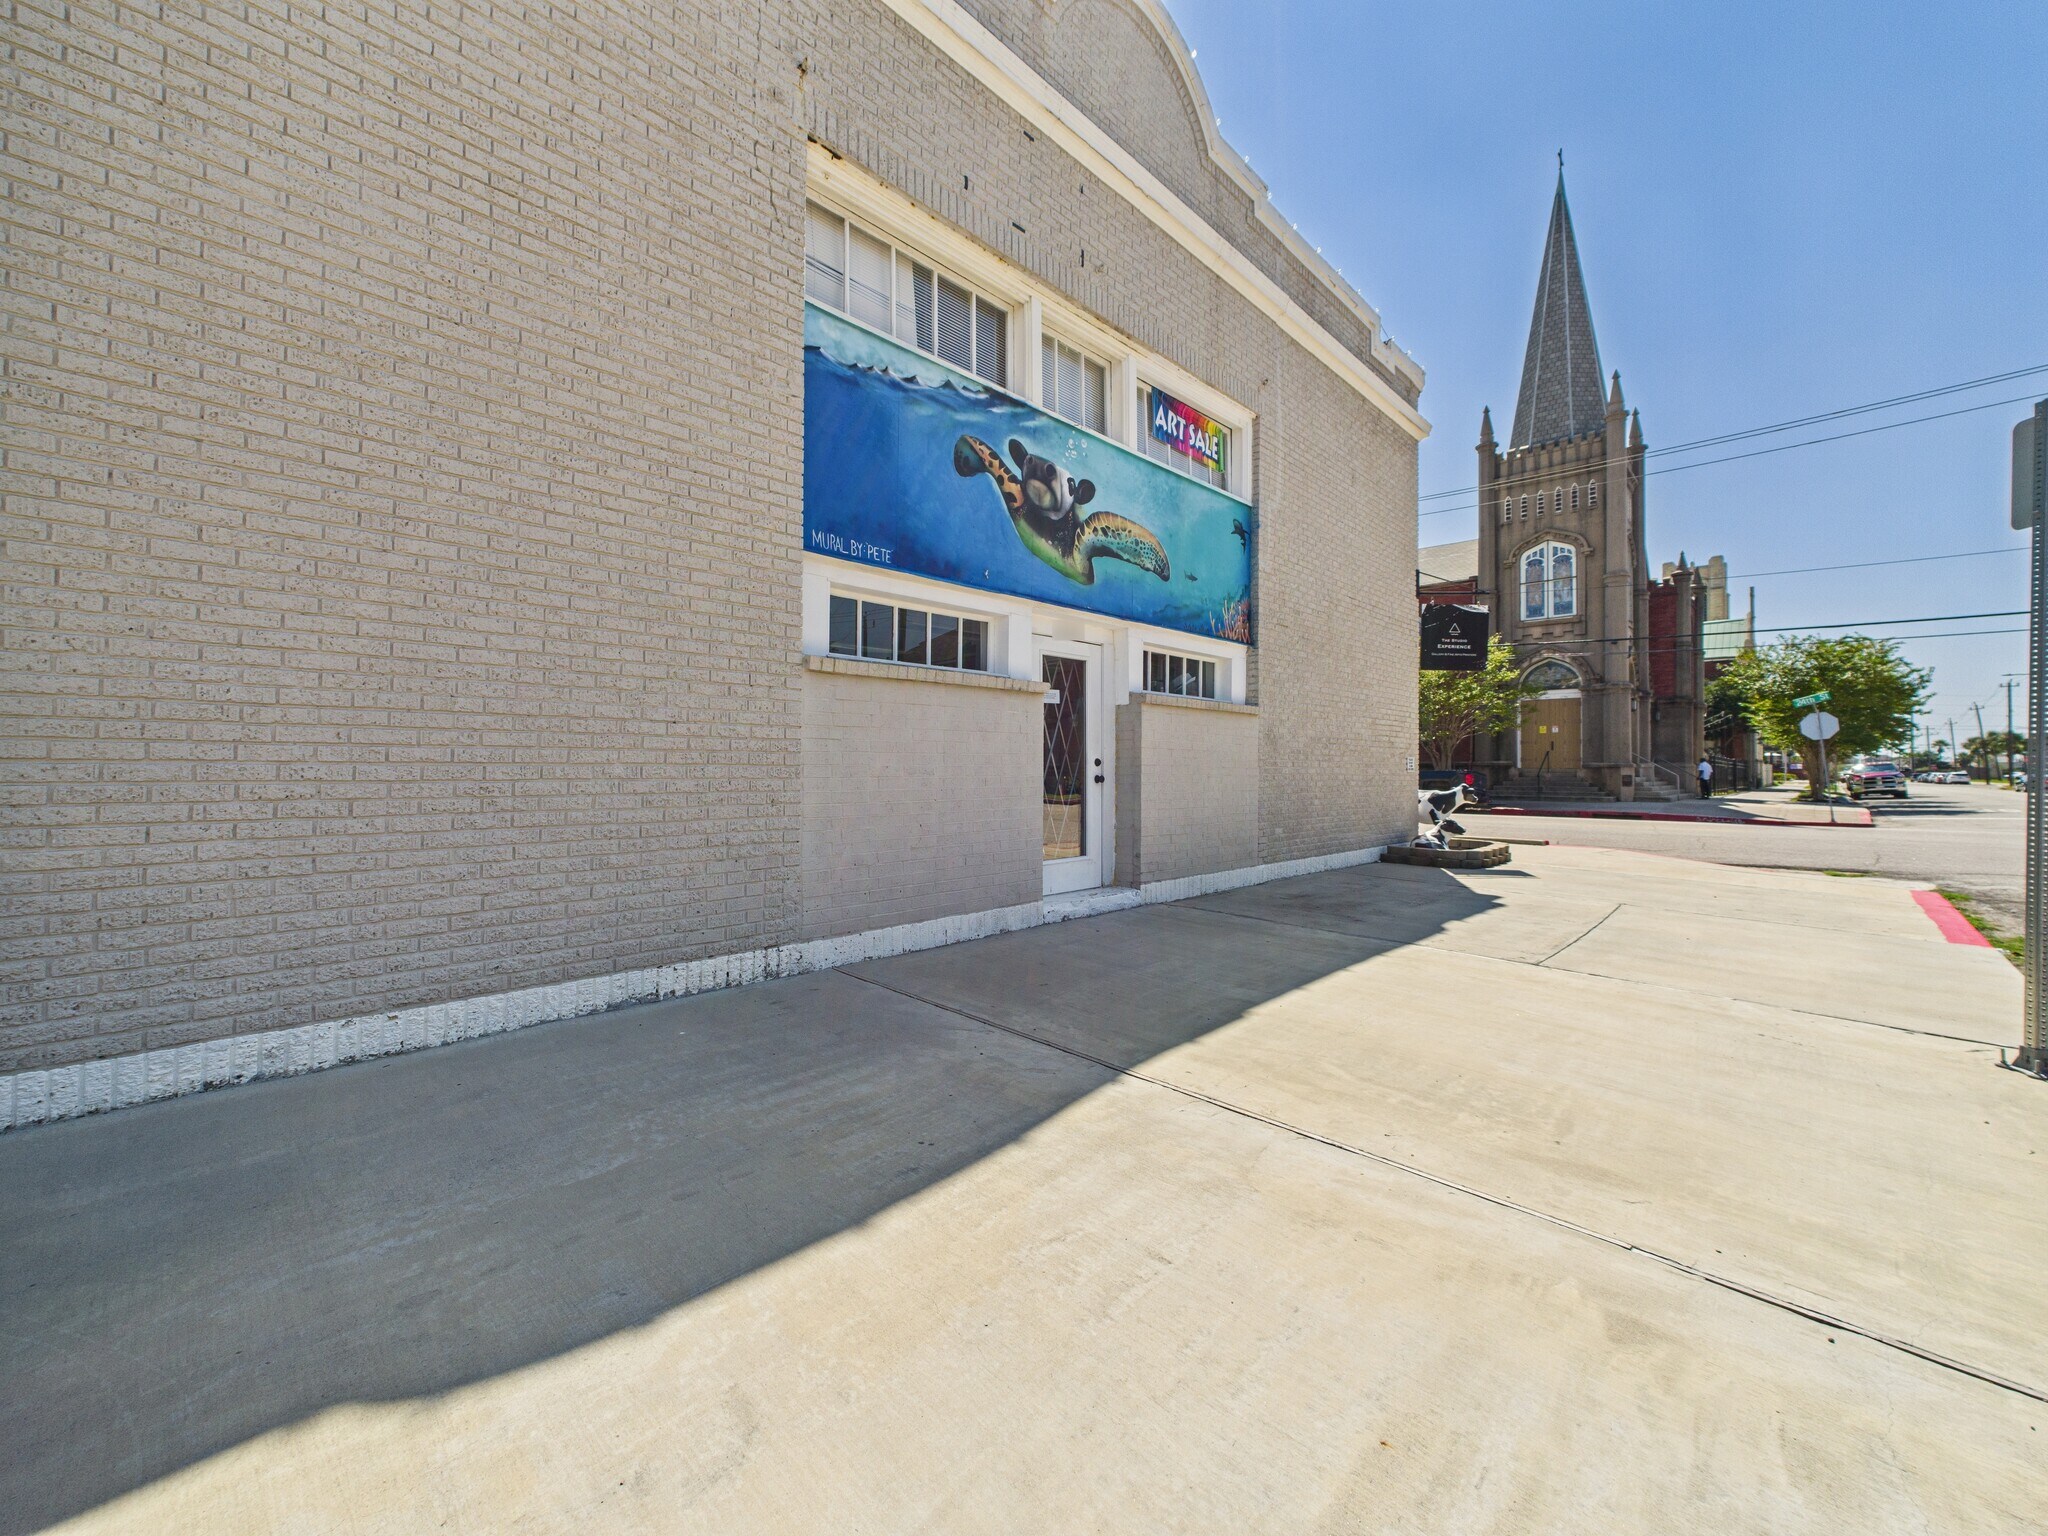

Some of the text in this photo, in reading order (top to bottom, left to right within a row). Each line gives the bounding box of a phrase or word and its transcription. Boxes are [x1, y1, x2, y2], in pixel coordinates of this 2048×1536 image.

[1155, 404, 1218, 461] ART SALE
[812, 528, 849, 554] MURAL
